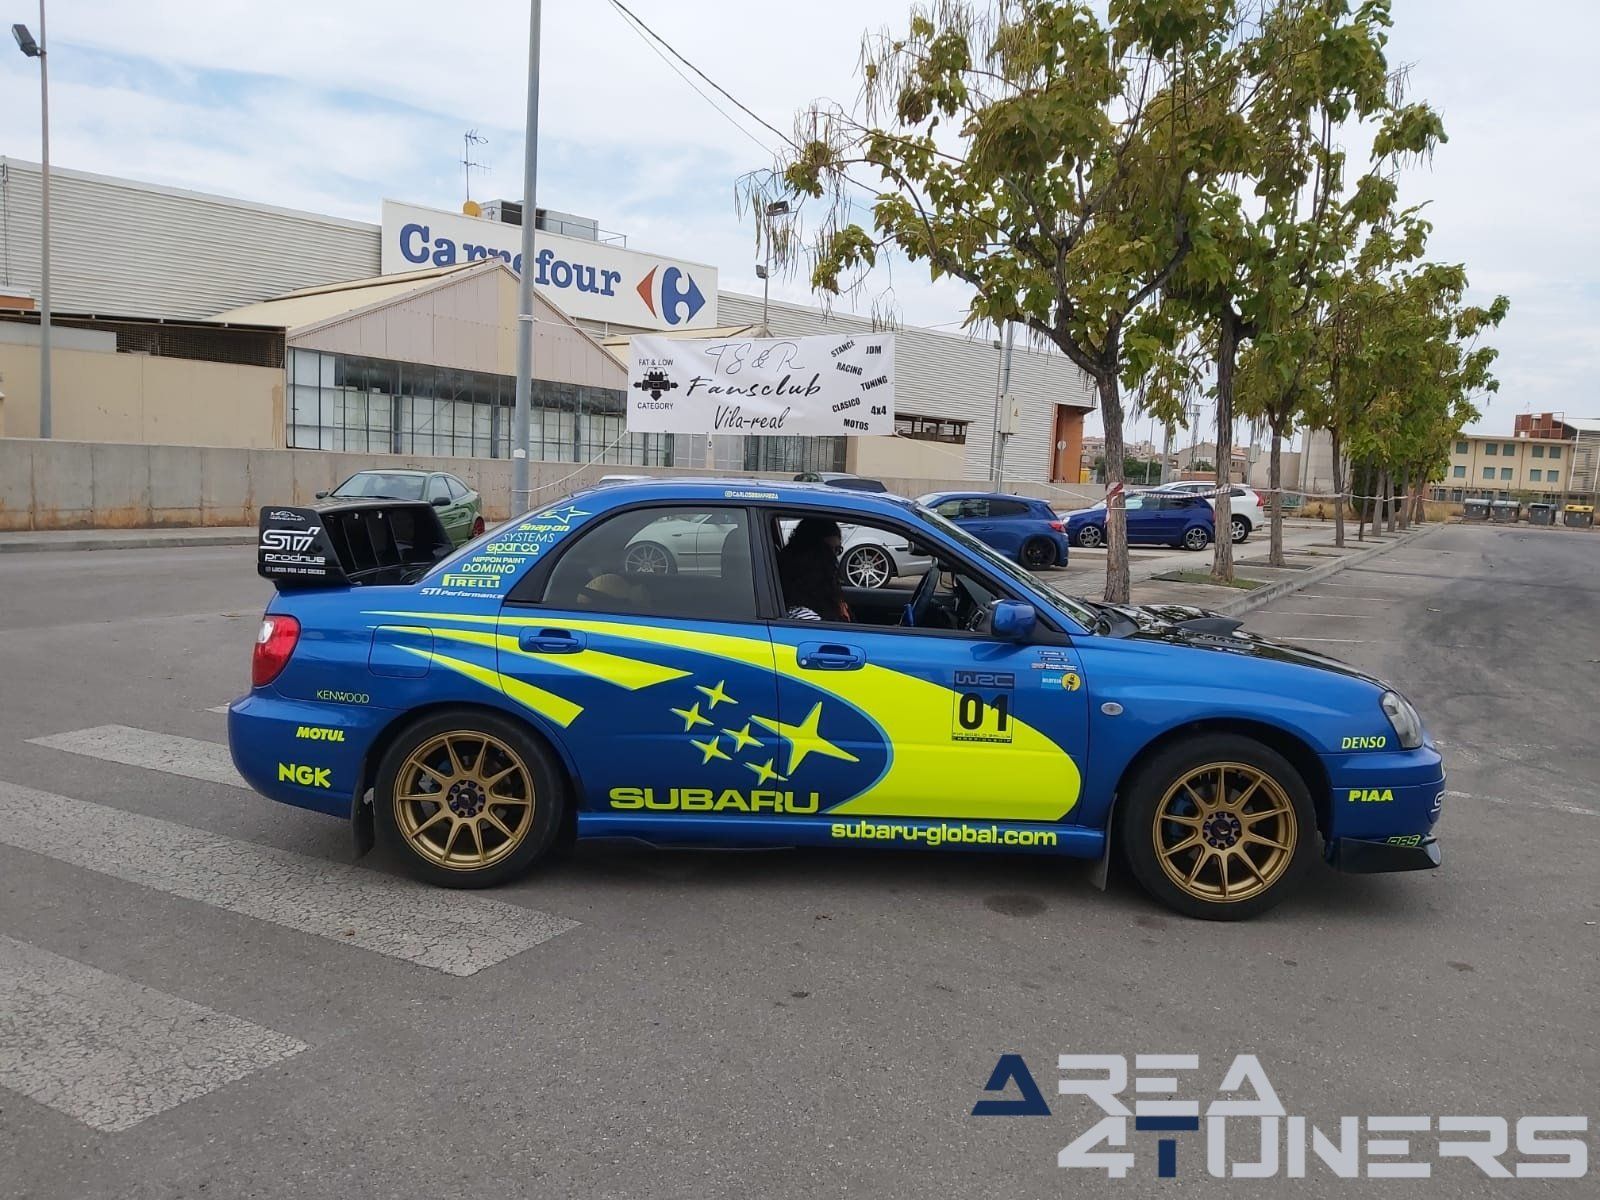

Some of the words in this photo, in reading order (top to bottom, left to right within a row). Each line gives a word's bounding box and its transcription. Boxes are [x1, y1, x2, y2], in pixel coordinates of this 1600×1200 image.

[831, 339, 856, 358] STANCE
[866, 345, 882, 355] JDM
[836, 361, 863, 376] RACING
[686, 372, 821, 397] Fansclub
[860, 375, 888, 391] TUNING
[637, 402, 674, 410] CATEGORY
[832, 397, 861, 413] CLASICO
[870, 405, 887, 415] 4x4
[714, 405, 791, 430] Vila-real
[843, 418, 869, 430] MOTOS
[501, 533, 555, 543] SYSTEMS
[485, 542, 540, 555] sparco
[462, 563, 516, 574] DOMINO
[442, 574, 501, 588] PIRELLI
[956, 673, 1014, 686] WRC
[316, 690, 370, 704] KENWOOD
[959, 693, 1008, 731] 01
[296, 726, 345, 742] MOTUL
[1341, 736, 1386, 749] DENSO
[278, 762, 332, 789] NGK
[609, 787, 819, 814] SUBARU
[1348, 789, 1394, 802] PIAA
[831, 821, 1057, 846] subaru-global.com
